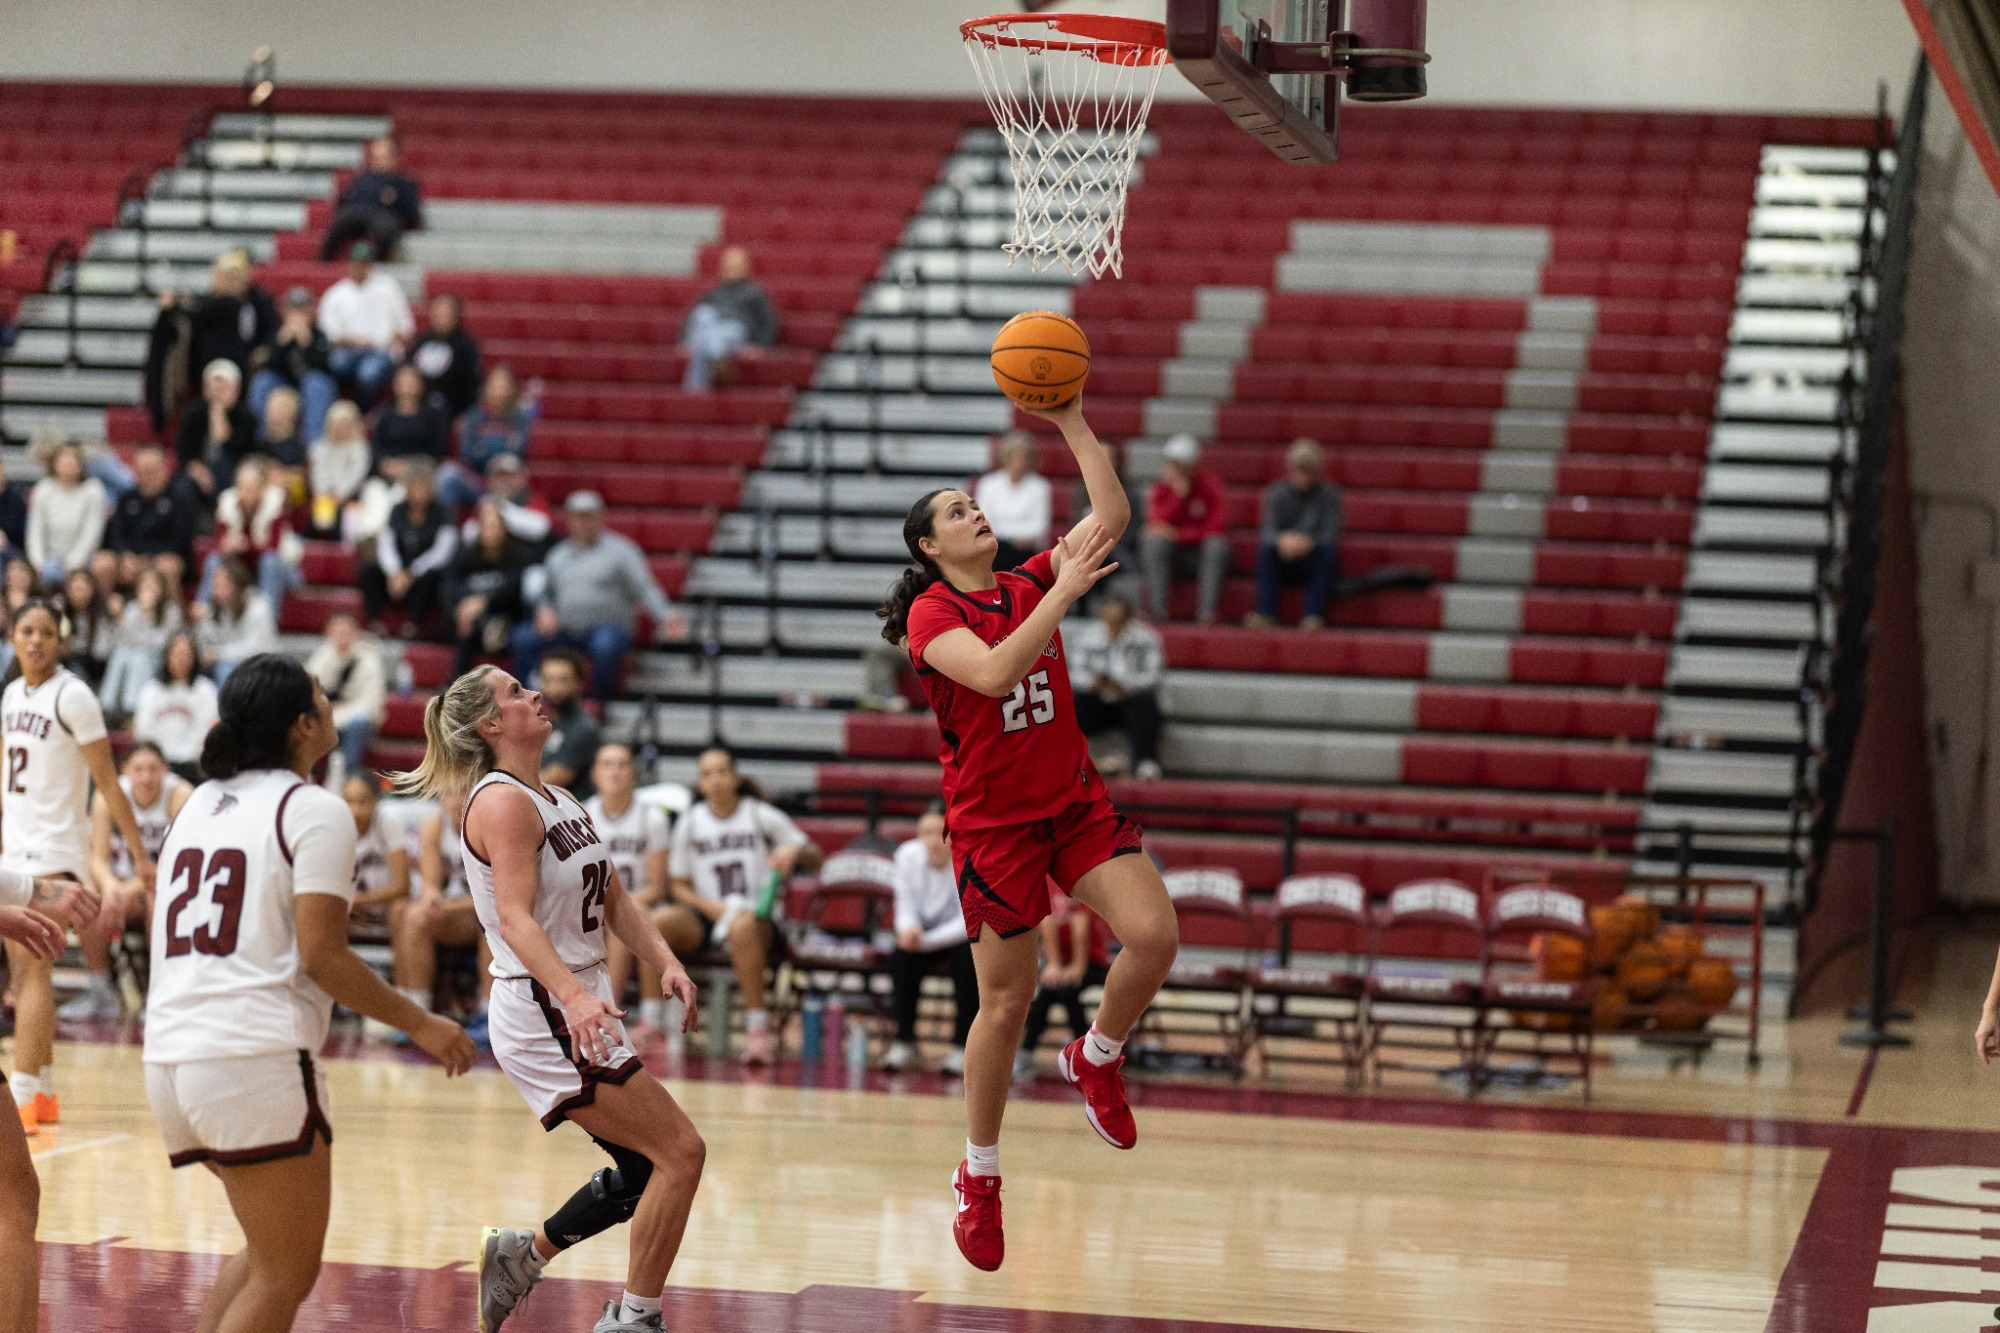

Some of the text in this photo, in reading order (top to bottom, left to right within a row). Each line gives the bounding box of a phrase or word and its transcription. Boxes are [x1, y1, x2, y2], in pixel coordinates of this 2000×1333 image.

[1001, 668, 1055, 734] 25
[8, 747, 28, 793] 12
[166, 848, 247, 960] 23
